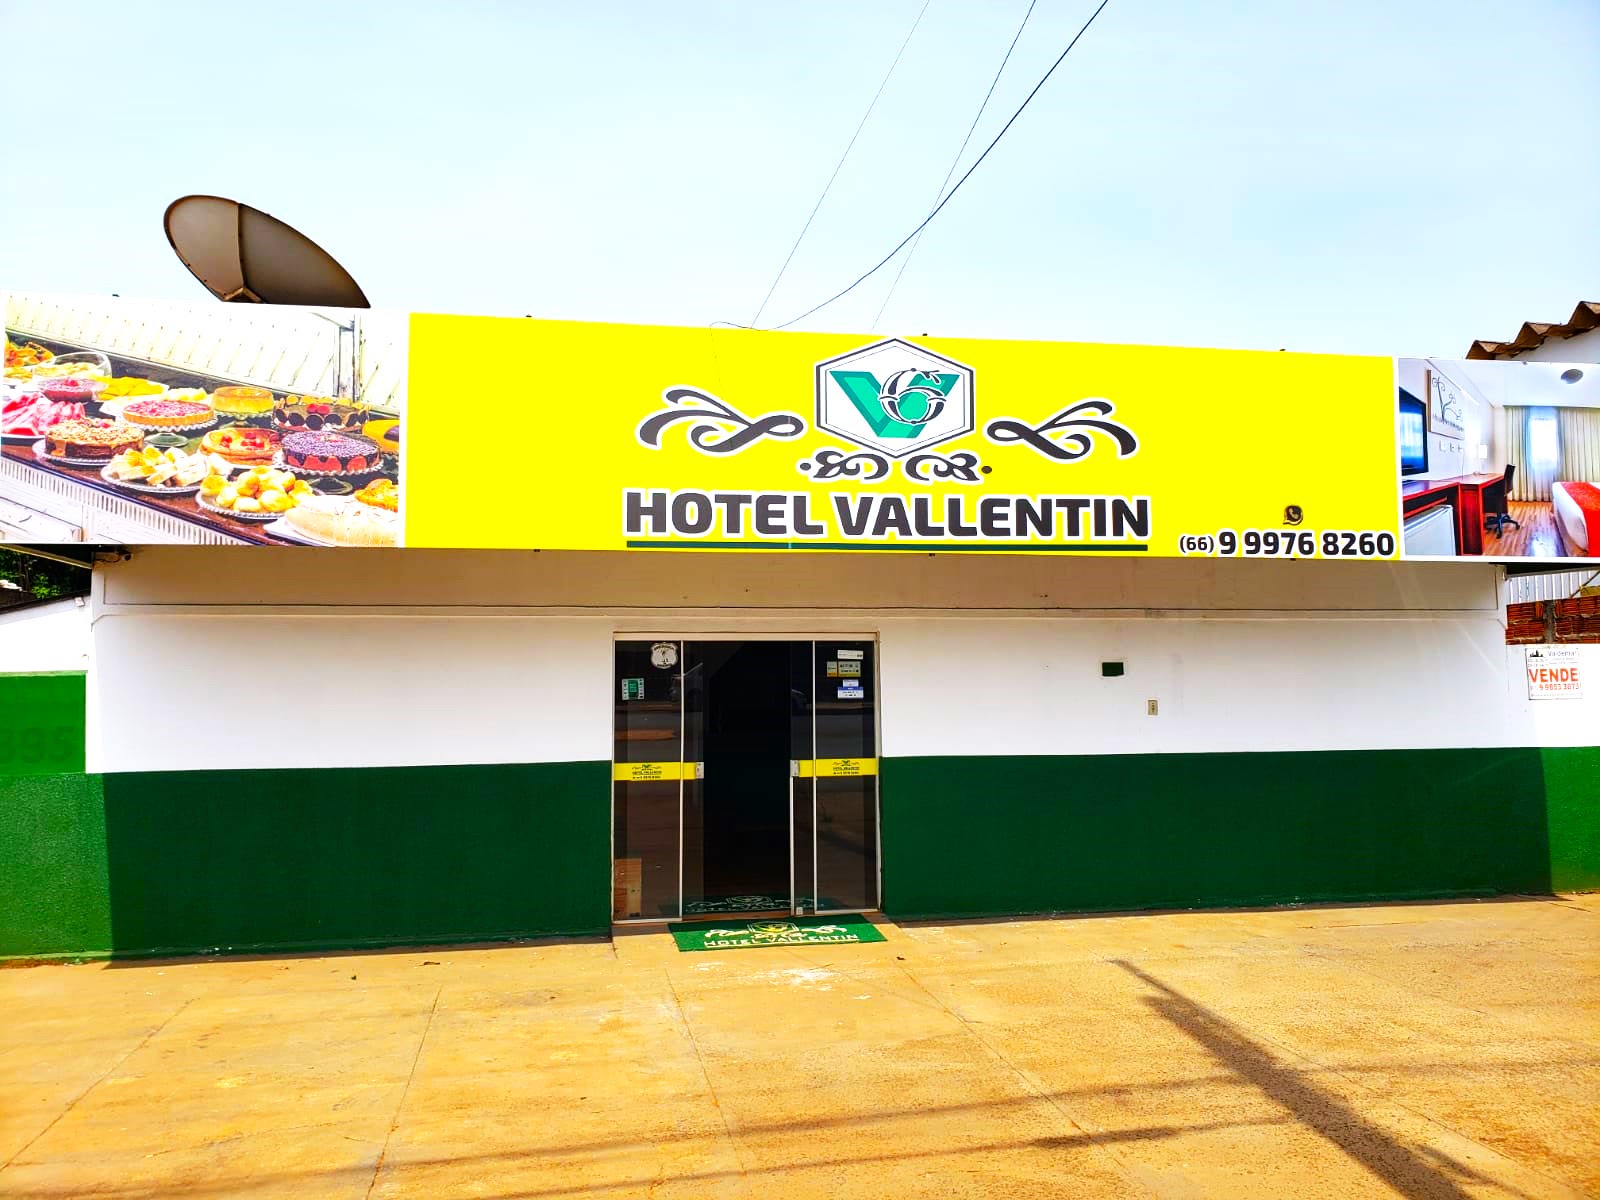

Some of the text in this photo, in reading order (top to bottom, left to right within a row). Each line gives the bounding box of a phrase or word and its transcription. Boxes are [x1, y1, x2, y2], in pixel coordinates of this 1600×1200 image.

[626, 491, 1149, 537] HOTEL VALLENTIN
[1179, 531, 1395, 556] (66) 9 9976 8260
[1528, 668, 1578, 683] VENDE
[704, 937, 756, 947] HOTEL
